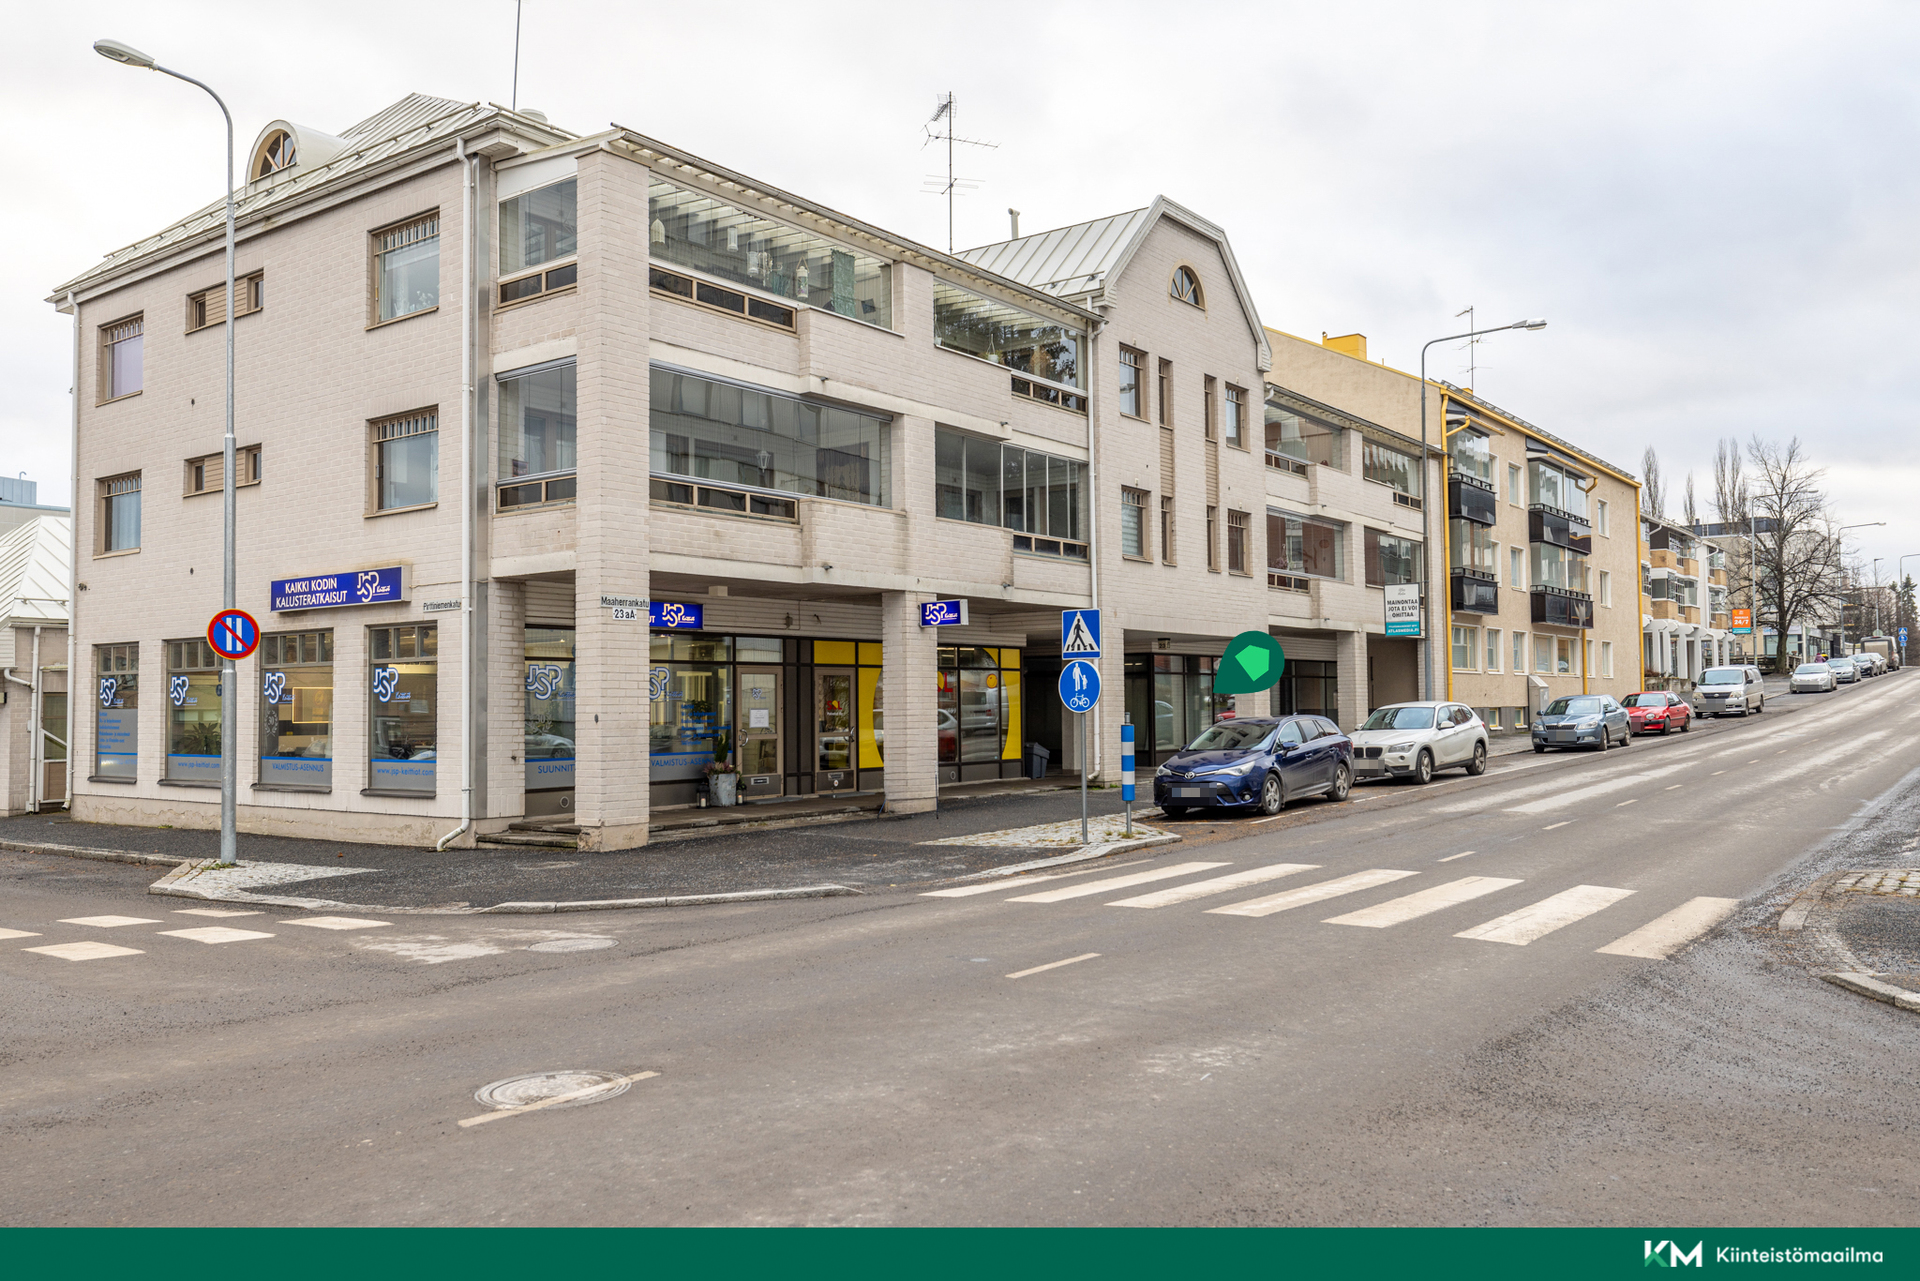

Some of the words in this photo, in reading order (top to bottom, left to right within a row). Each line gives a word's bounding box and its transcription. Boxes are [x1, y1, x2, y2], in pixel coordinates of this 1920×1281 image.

[285, 580, 309, 594] KAIKKI
[311, 577, 338, 592] KODIN
[356, 571, 380, 603] JSP
[275, 590, 348, 608] KALUSTERATKAISUT
[601, 596, 650, 608] Maaherrankatu
[661, 603, 685, 627] JSP
[925, 603, 947, 625] JSP
[170, 675, 189, 706] JSP
[264, 672, 286, 704] JSP
[373, 667, 399, 703] JSP
[526, 664, 563, 700] JSP
[272, 763, 325, 773] VALMISTUS-ASENNUS
[377, 767, 435, 776] www.jsp-keittiot.com
